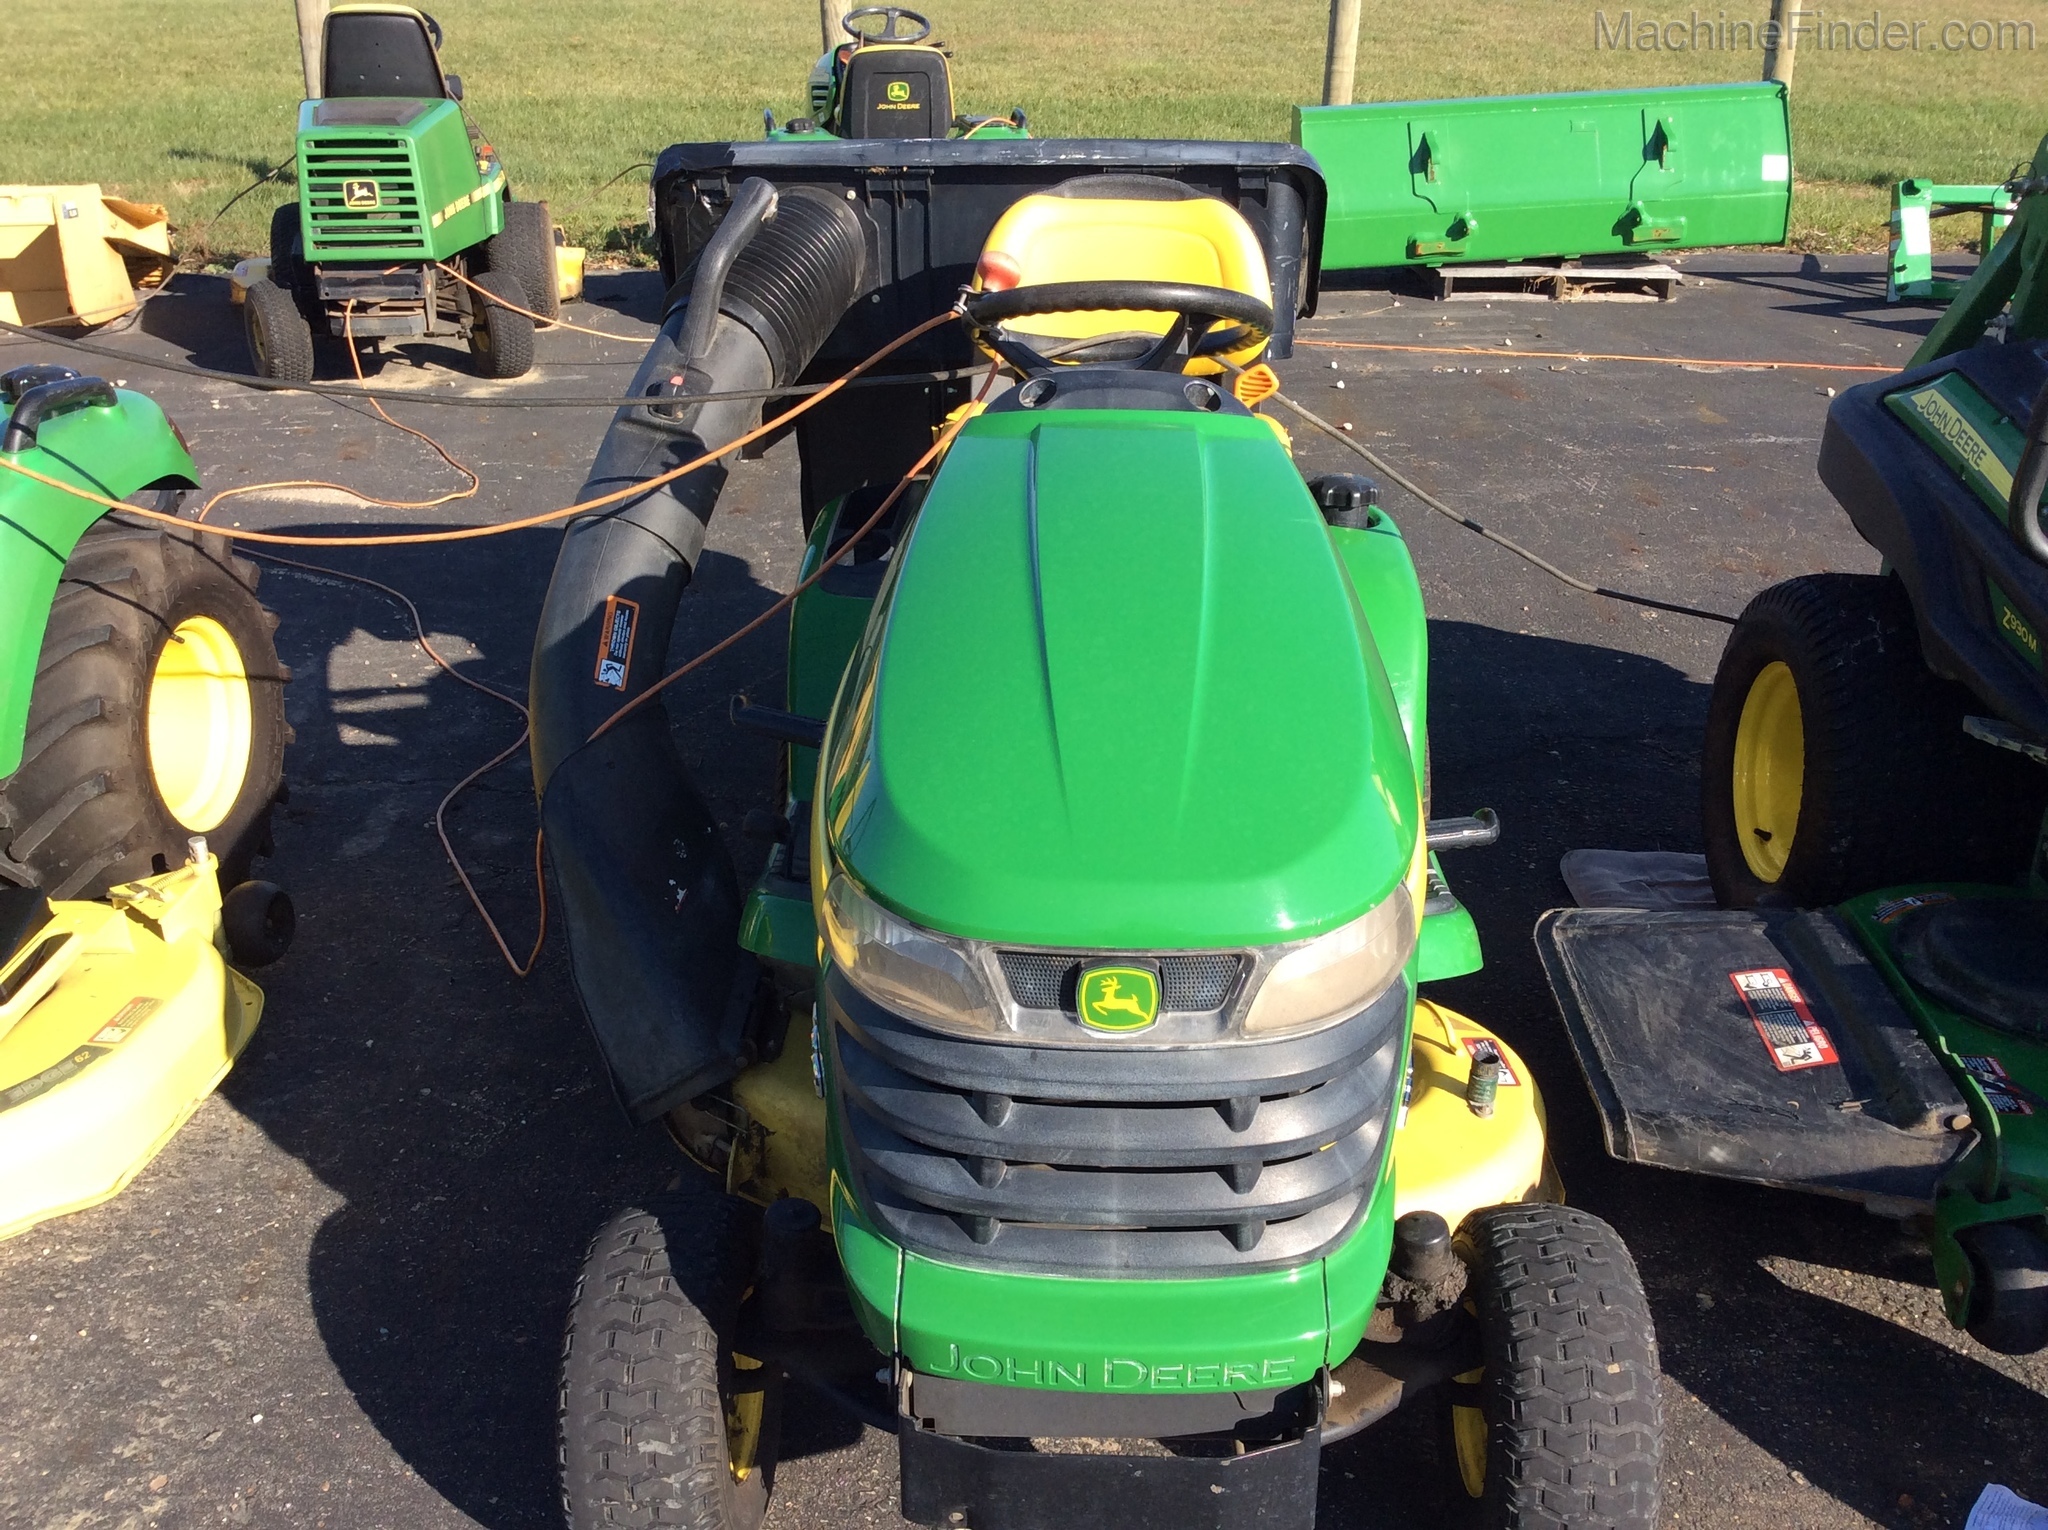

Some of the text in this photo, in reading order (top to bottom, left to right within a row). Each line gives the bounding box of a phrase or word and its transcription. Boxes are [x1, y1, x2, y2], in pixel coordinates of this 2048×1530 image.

[1919, 393, 1987, 468] JOHN DEERE
[2003, 606, 2037, 653] Z930M
[74, 1051, 91, 1064] 62
[930, 1343, 1296, 1389] JOHN DEERE
